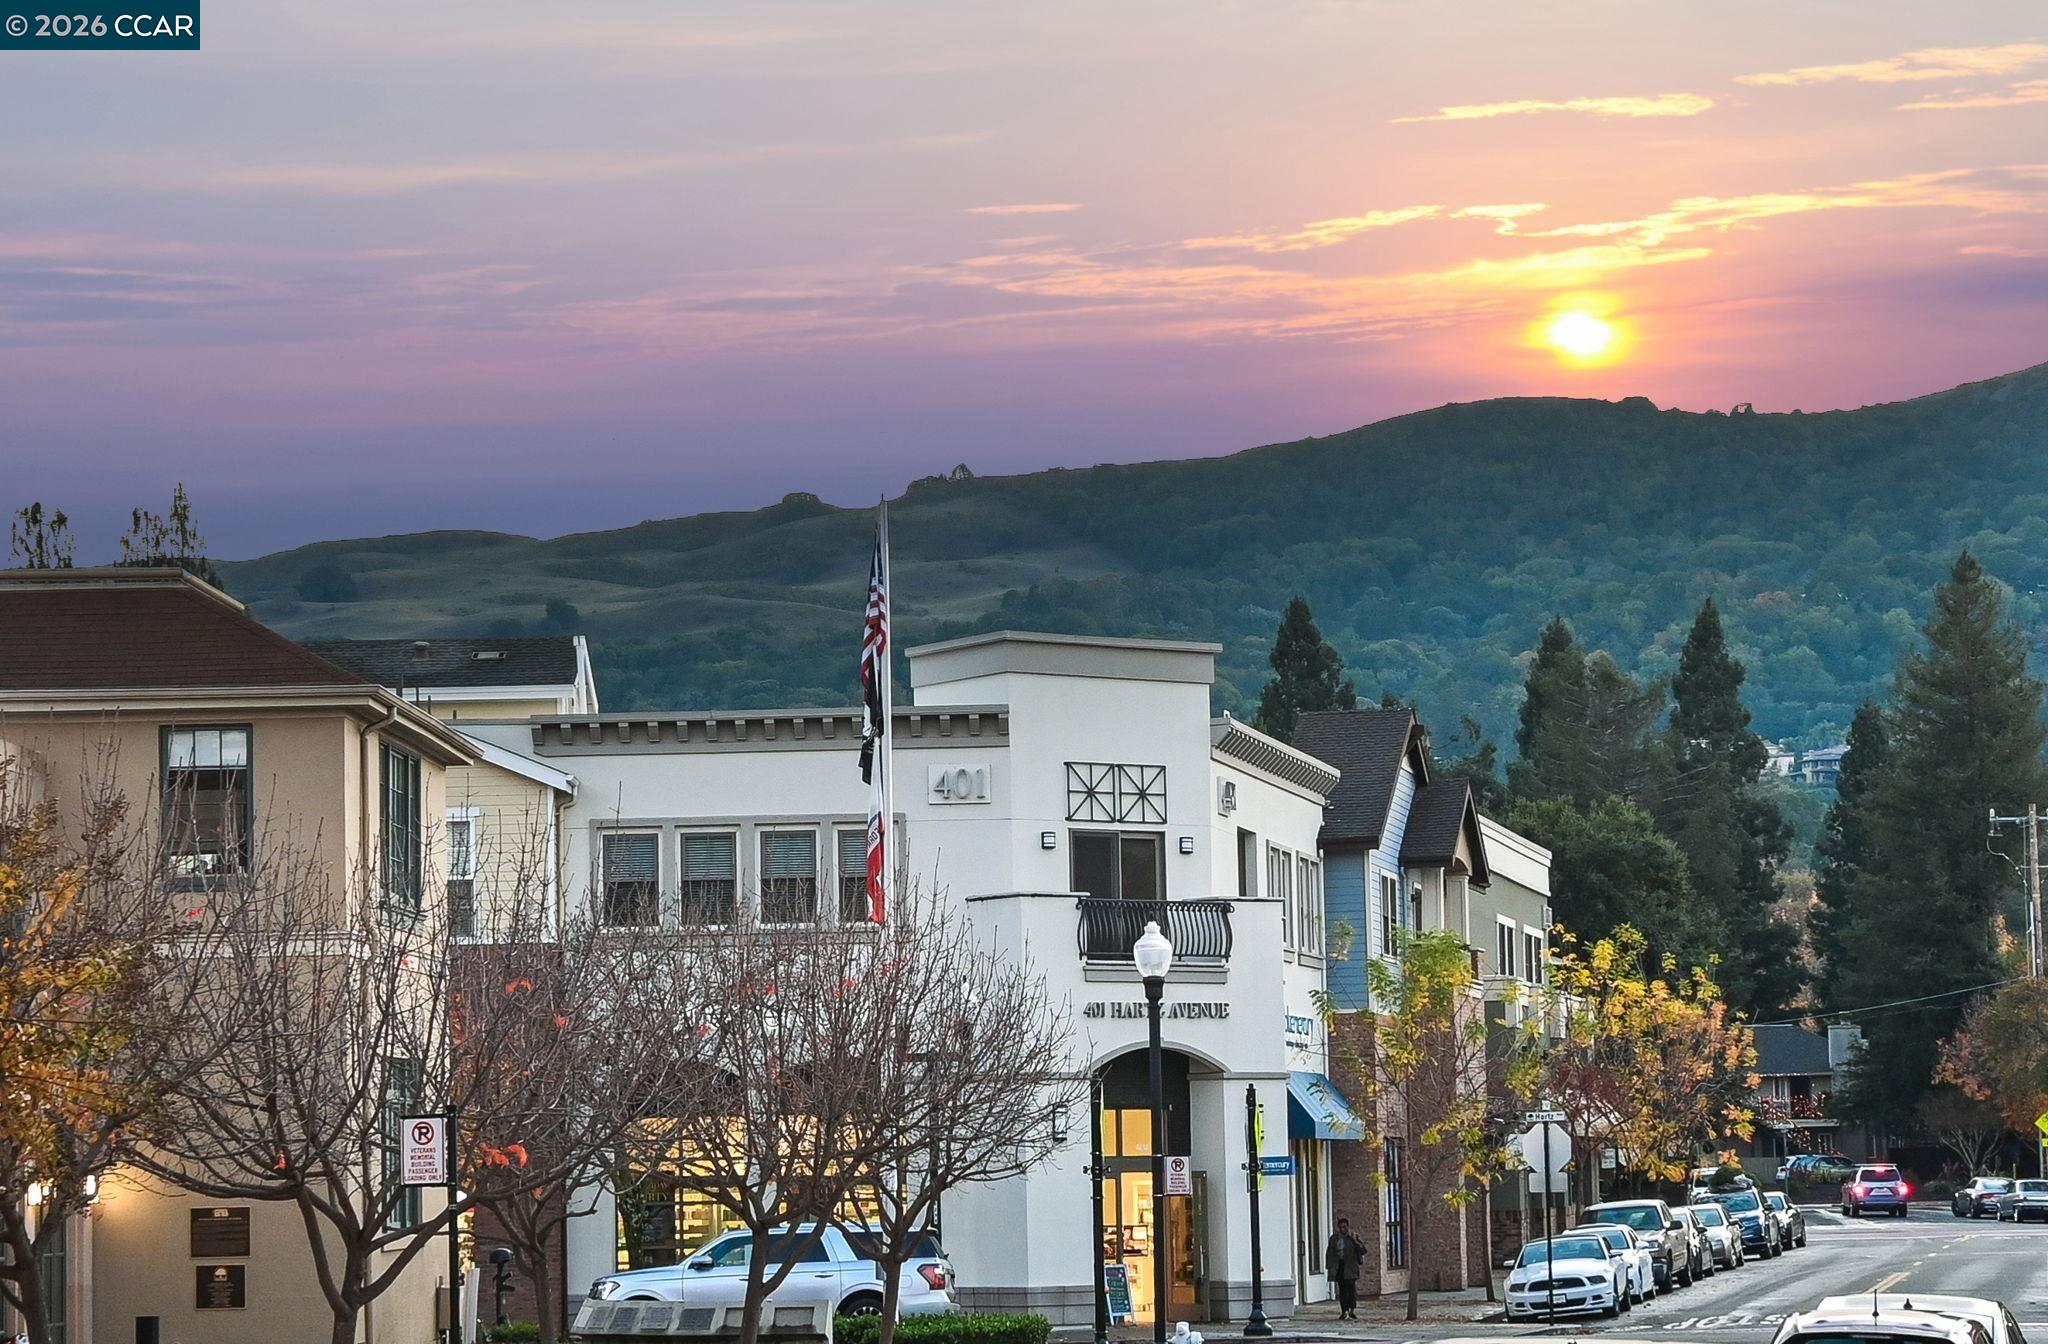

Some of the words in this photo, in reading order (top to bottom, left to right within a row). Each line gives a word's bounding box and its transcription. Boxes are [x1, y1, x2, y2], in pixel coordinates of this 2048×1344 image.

[933, 768, 986, 800] 401
[1083, 1002, 1106, 1018] 401
[1167, 1002, 1230, 1019] AVENUE
